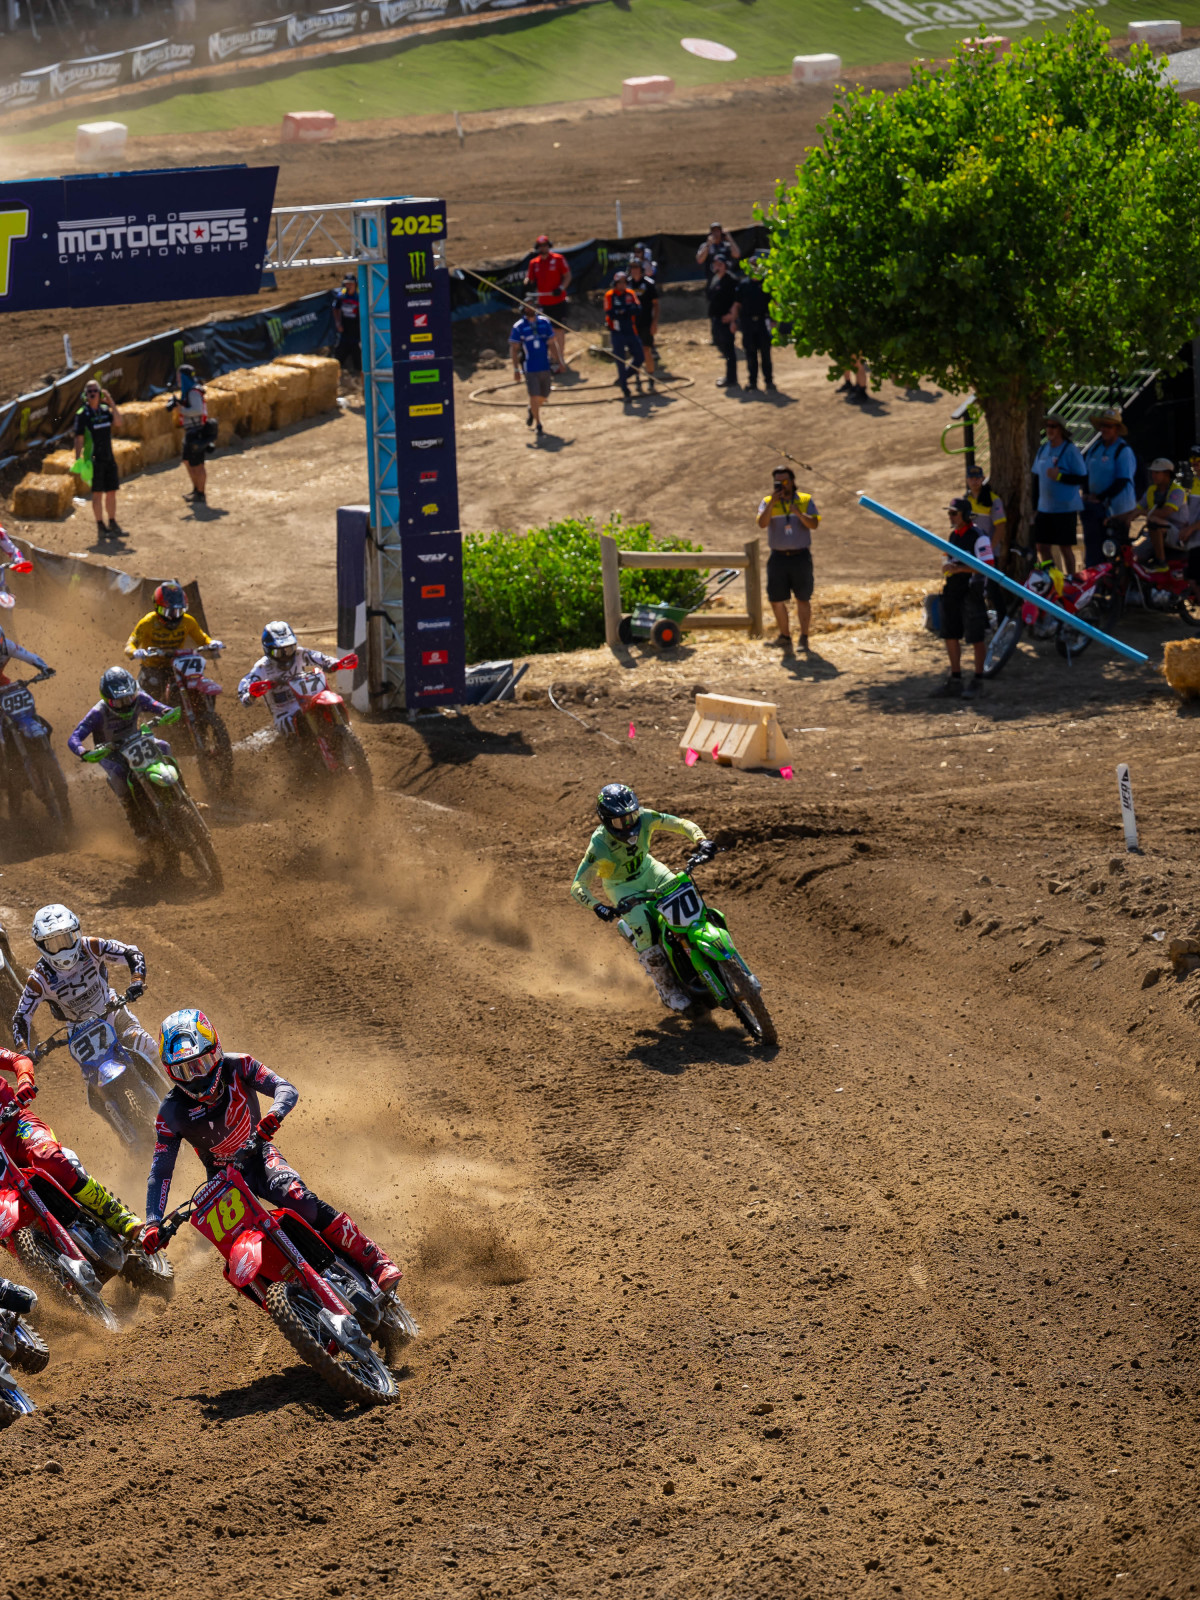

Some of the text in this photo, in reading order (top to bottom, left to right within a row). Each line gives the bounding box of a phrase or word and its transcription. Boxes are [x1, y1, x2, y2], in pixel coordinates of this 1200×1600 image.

[127, 211, 178, 225] PRO
[390, 214, 444, 236] 2025
[57, 218, 248, 254] MOTOCROSS
[59, 241, 249, 264] CHAMPIONSHIP
[179, 657, 203, 674] 74
[2, 692, 33, 714] 992
[127, 742, 158, 768] 33
[661, 888, 701, 927] 70
[74, 1024, 109, 1064] 37
[195, 1176, 225, 1206] RENTHAL
[206, 1186, 246, 1243] 18
[313, 1273, 345, 1311] DUNLOP
